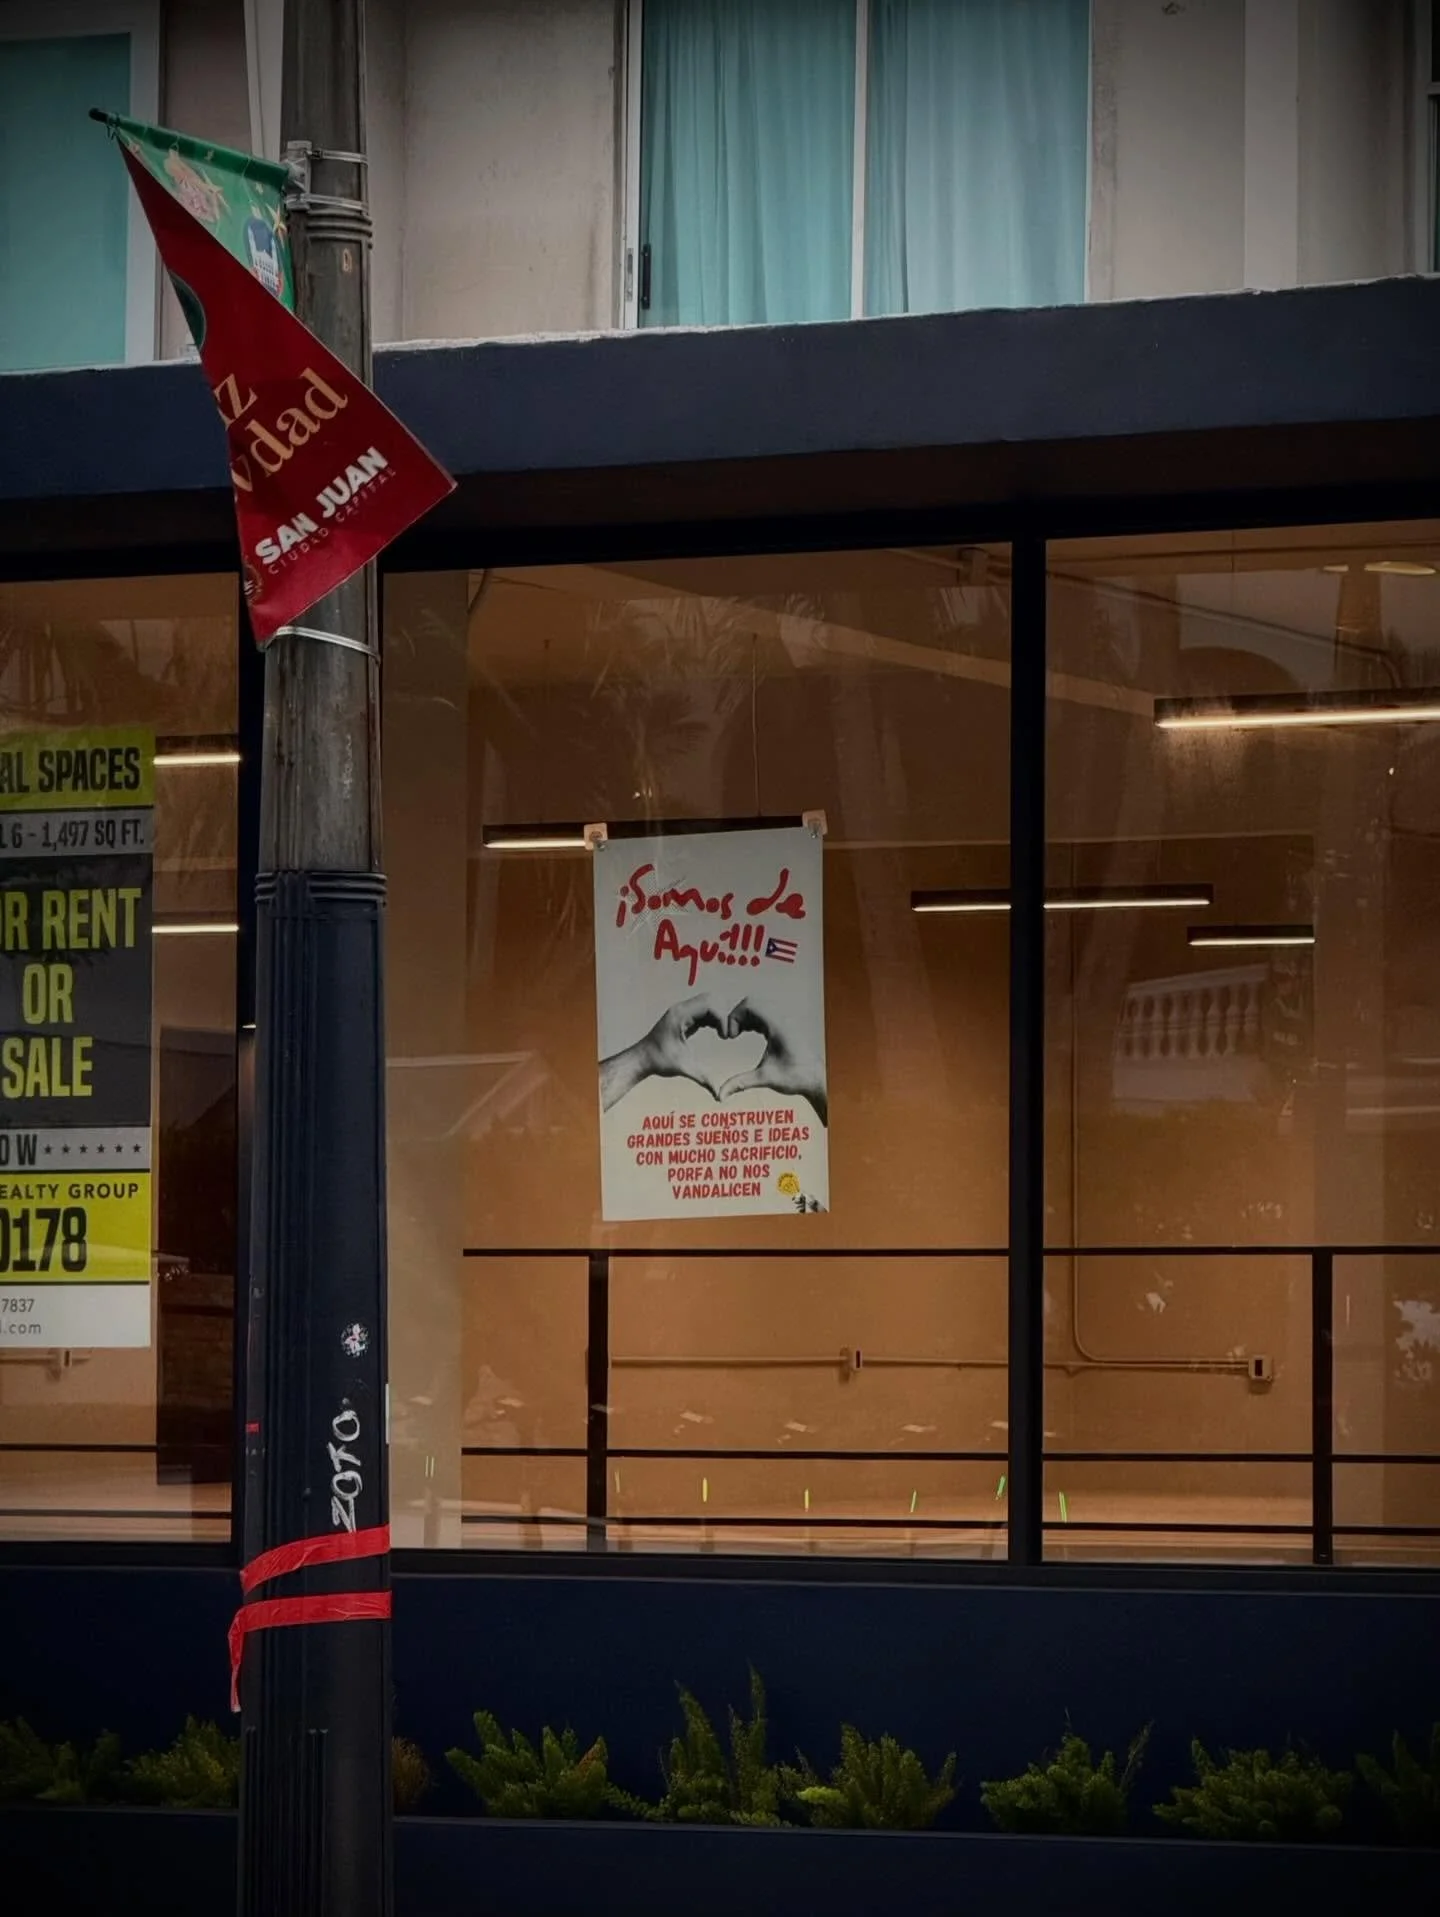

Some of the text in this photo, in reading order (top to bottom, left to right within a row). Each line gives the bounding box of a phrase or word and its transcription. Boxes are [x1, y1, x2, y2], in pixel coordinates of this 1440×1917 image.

[255, 446, 389, 565] SAN JUAN
[268, 528, 329, 575] CIUDAD
[38, 747, 142, 793] SPACES
[42, 819, 89, 852] 1,497
[95, 819, 116, 849] SQ
[121, 818, 145, 845] FT.
[746, 867, 807, 920] de
[42, 887, 142, 950] RENT
[22, 963, 74, 1025] OR
[2, 1036, 93, 1098] SALE
[626, 1126, 810, 1149] GRANDES SUEÑOS E IDEAS
[642, 1109, 794, 1130] AQUÍ SE CONSTRUYEN
[636, 1150, 664, 1166] CON
[668, 1148, 716, 1165] MUCHO
[667, 1163, 771, 1182] PORFA NO NOS
[68, 1183, 139, 1200] GROUP
[672, 1182, 762, 1200] VANDALICEN
